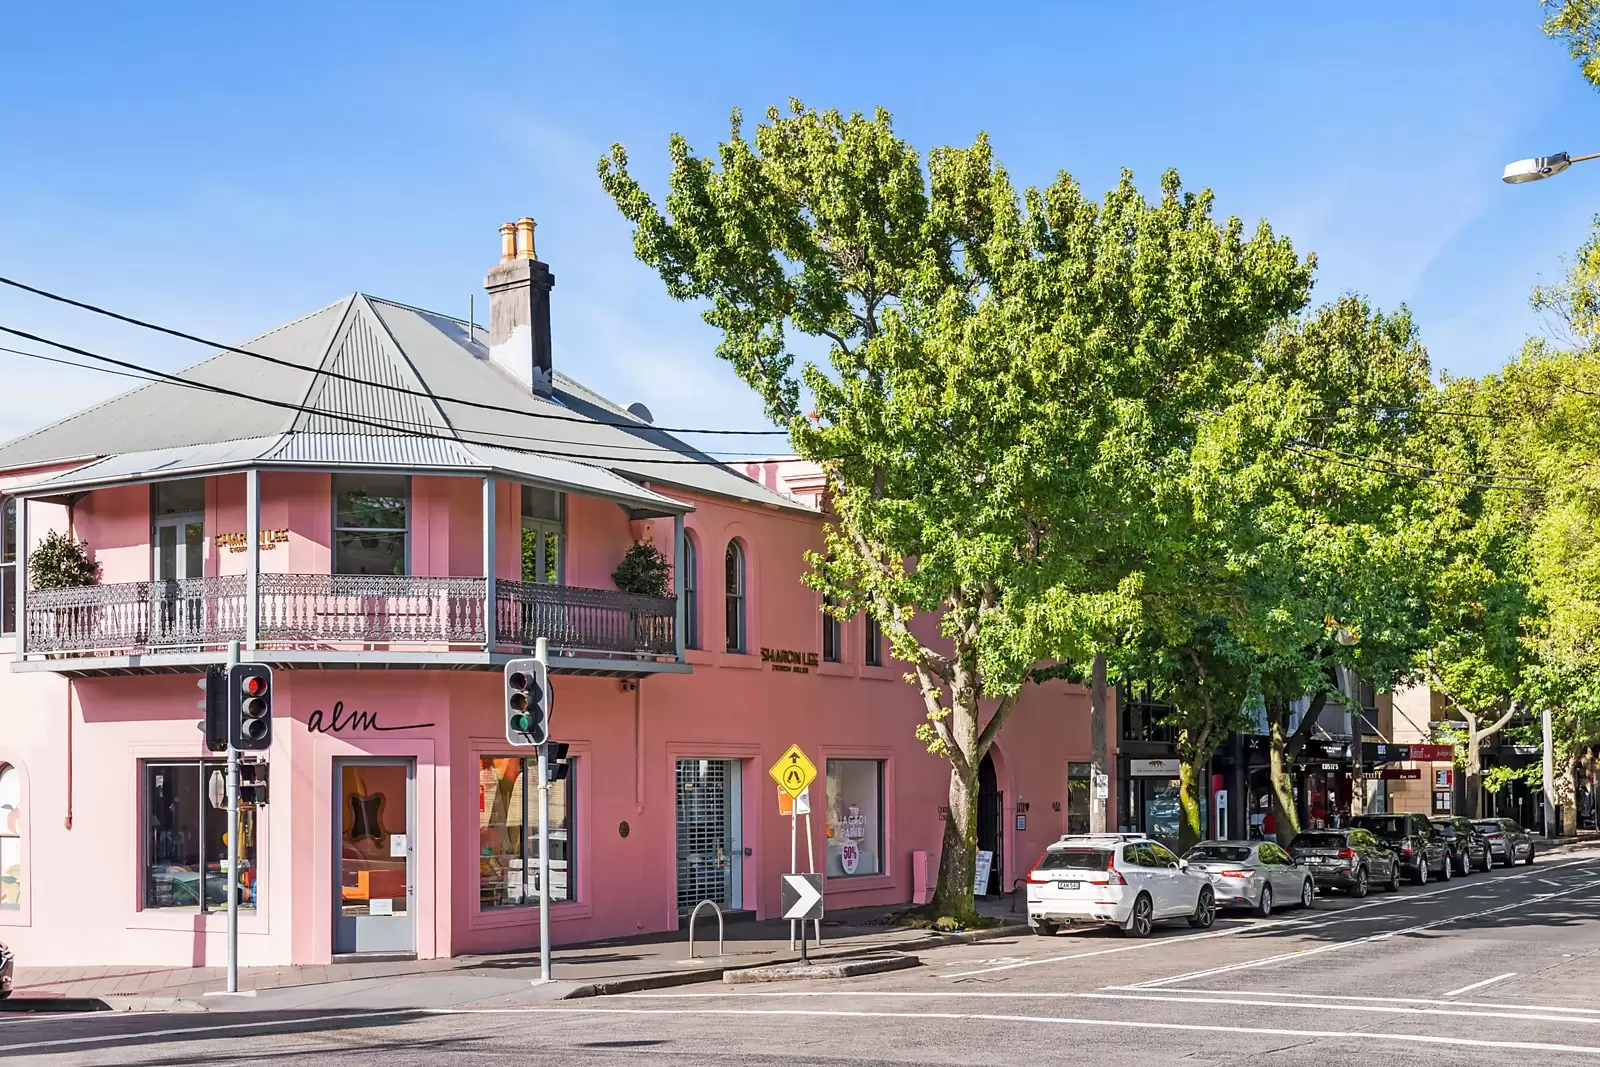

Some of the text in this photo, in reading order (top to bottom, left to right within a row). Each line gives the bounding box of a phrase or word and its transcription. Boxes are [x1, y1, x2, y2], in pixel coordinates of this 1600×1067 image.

[760, 648, 819, 666] SHARON LEE
[308, 701, 435, 732] alm
[843, 846, 857, 859] 50%
